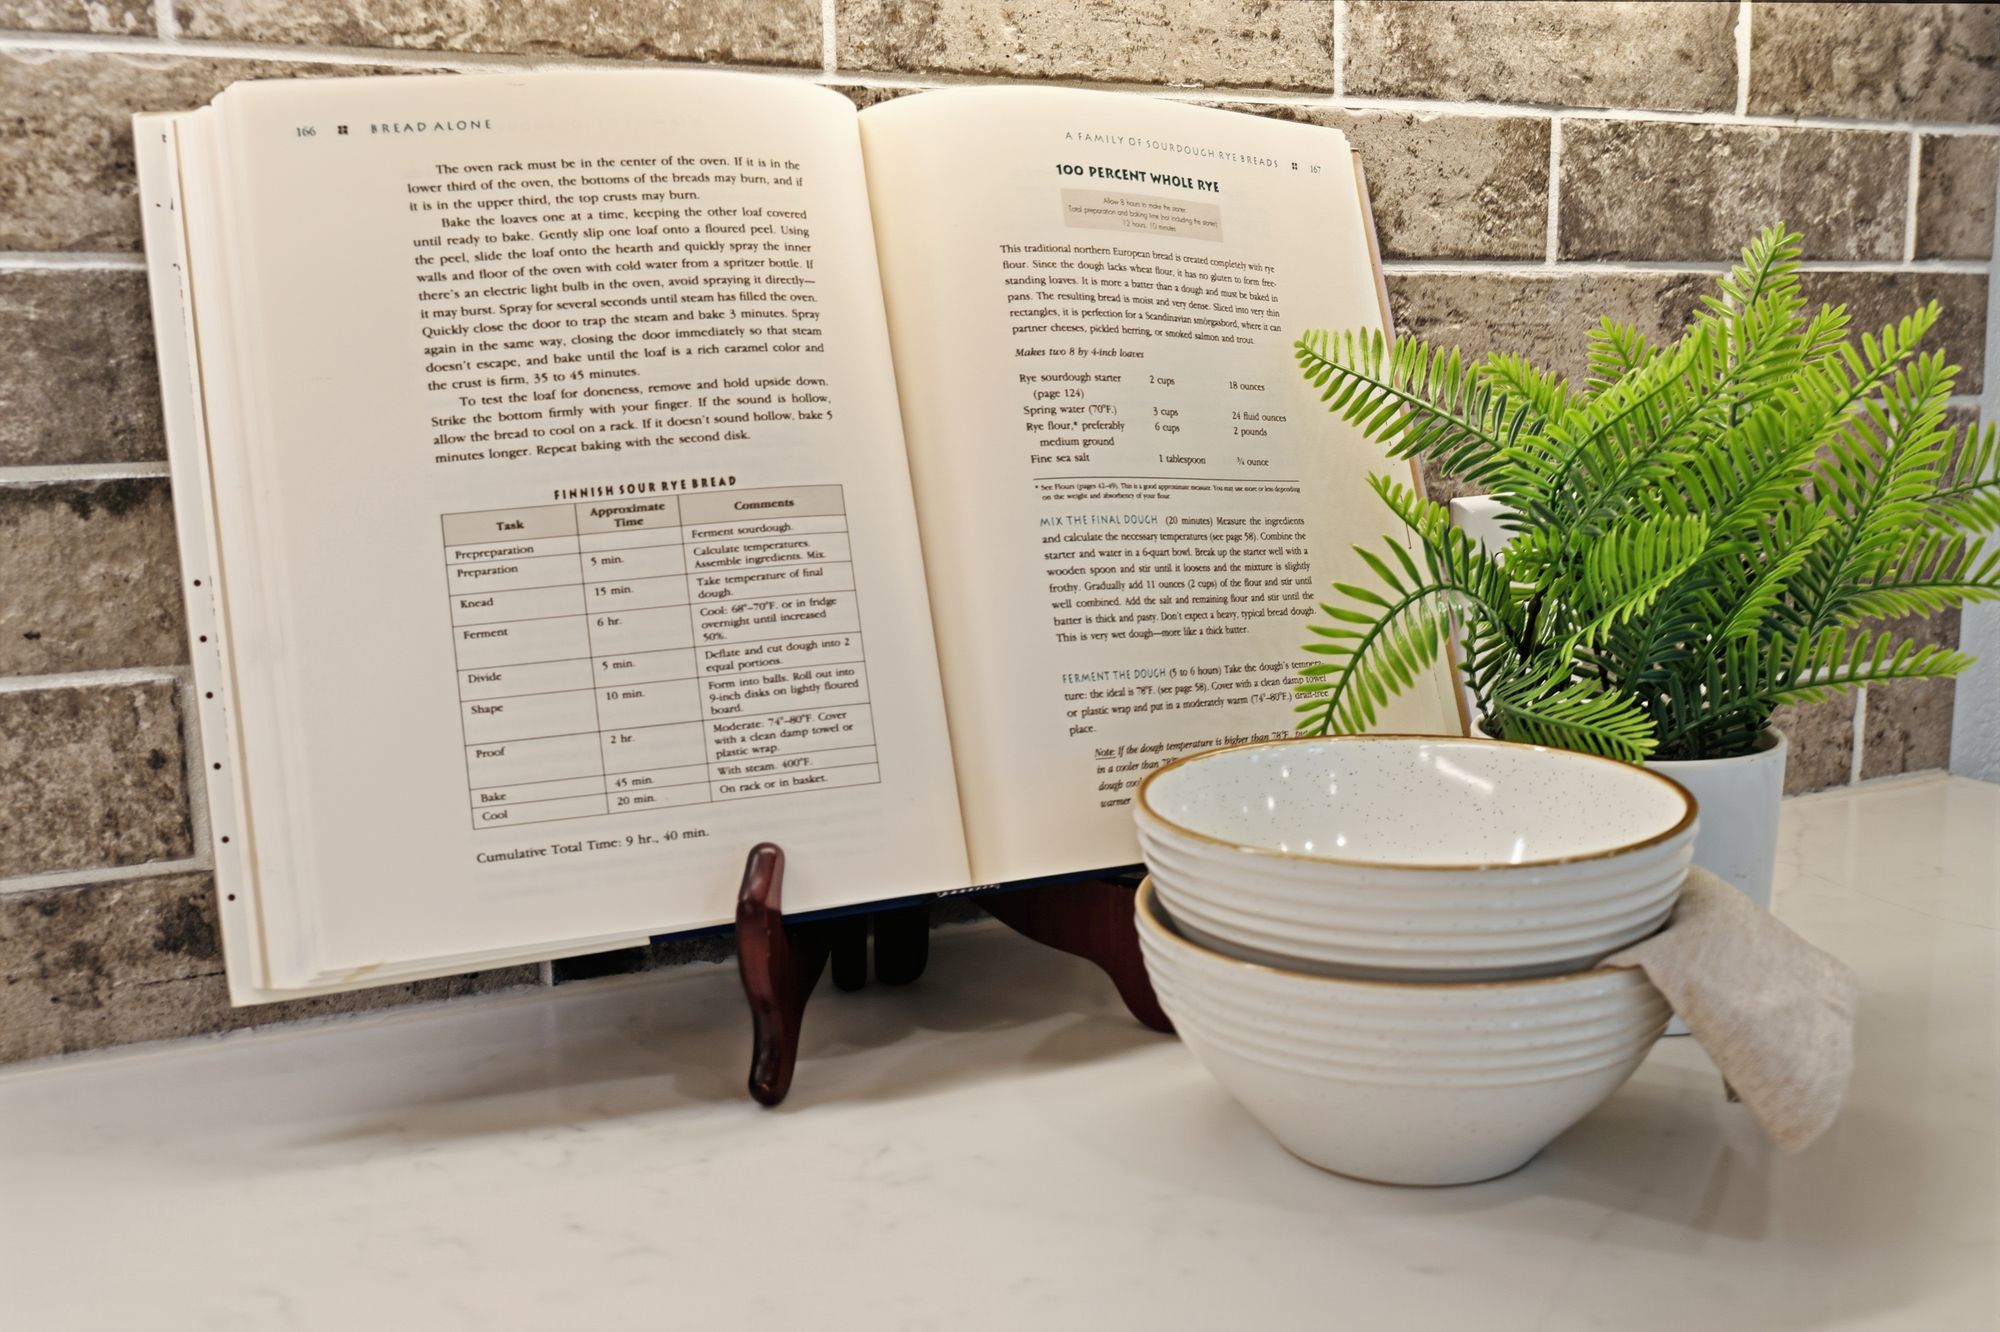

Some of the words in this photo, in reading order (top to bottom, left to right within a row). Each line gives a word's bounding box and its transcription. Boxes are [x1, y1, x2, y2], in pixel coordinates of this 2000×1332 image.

[296, 125, 317, 138] 166
[370, 122, 427, 134] BREAD
[434, 118, 493, 131] ALONE
[1065, 131, 1074, 140] A
[1078, 132, 1124, 144] FAMILY
[1128, 137, 1142, 146] OF
[1146, 139, 1215, 158] SOURDOUGH
[1218, 151, 1237, 162] RYE
[1240, 154, 1279, 169] BREADS
[434, 163, 460, 175] The
[463, 164, 494, 174] oven
[497, 160, 524, 172] rack
[526, 160, 558, 171] must
[560, 158, 576, 169] be
[580, 158, 593, 169] in
[596, 156, 616, 168] the
[619, 157, 657, 168] center
[660, 155, 674, 167] of
[676, 154, 696, 166] the
[698, 157, 730, 167] oven.
[733, 155, 744, 167] If
[746, 157, 755, 168] it
[757, 157, 767, 168] is
[769, 158, 781, 169] in
[783, 159, 801, 171] the
[1309, 164, 1322, 175] 167
[1055, 163, 1084, 176] 100
[1088, 165, 1147, 183] PERCENT
[1149, 172, 1194, 190] WHOLE
[1196, 178, 1220, 193] RYE
[440, 216, 471, 229] Bake
[475, 215, 496, 227] the
[500, 213, 539, 225] loaves
[541, 213, 566, 223] one
[570, 212, 582, 222] at
[586, 212, 594, 221] a
[597, 209, 629, 221] time,
[632, 207, 681, 221] keeping
[683, 206, 703, 217] the
[706, 205, 738, 217] other
[741, 206, 763, 217] loaf
[766, 209, 808, 220] covered
[999, 244, 1022, 254] This
[1023, 243, 1072, 253] traditional
[1073, 245, 1111, 255] northern
[1112, 247, 1151, 260] European
[1151, 250, 1174, 261] bread
[1175, 255, 1182, 263] is
[1182, 256, 1209, 266] created
[1209, 259, 1247, 272] completely
[1247, 263, 1263, 272] with
[1264, 265, 1275, 275] rye
[421, 323, 470, 340] Quickly
[472, 322, 505, 334] close
[508, 320, 528, 332] the
[531, 318, 562, 330] door
[565, 319, 579, 328] to
[581, 317, 607, 329] trap
[610, 313, 630, 325] the
[633, 313, 669, 324] steam
[672, 309, 695, 321] and
[697, 308, 726, 320] bake
[729, 308, 737, 320] 3
[740, 308, 788, 319] minutes.
[791, 308, 820, 322] Spray
[1015, 347, 1046, 358] Makes
[1048, 348, 1067, 356] two
[1068, 346, 1076, 356] 8
[1077, 346, 1089, 359] by
[1090, 347, 1118, 358] 4-inch
[1119, 348, 1145, 359] loaves
[1018, 373, 1037, 385] Rye
[1040, 371, 1092, 384] sourdough
[1094, 374, 1122, 383] starter
[1149, 374, 1155, 384] 2
[1156, 377, 1176, 387] cups
[1229, 380, 1239, 391] 18
[1239, 383, 1266, 392] ounces
[435, 452, 486, 464] minutes
[488, 448, 531, 460] longer.
[536, 444, 577, 457] Repeat
[580, 440, 622, 452] baking
[624, 436, 652, 448] with
[655, 434, 675, 446] the
[678, 431, 721, 444] second
[723, 429, 751, 441] disk.
[1039, 436, 1080, 447] medium
[1082, 436, 1115, 449] ground
[1030, 454, 1053, 464] Fine
[1055, 455, 1072, 463] sea
[1074, 452, 1090, 462] salt
[1159, 454, 1163, 463] 1
[1165, 454, 1207, 466] tablespoon
[553, 484, 615, 501] FINNISH
[618, 481, 657, 496] SOUR
[660, 478, 687, 492] RYE
[691, 475, 737, 490] BREAD
[589, 502, 666, 517] Approximate
[733, 498, 796, 511] Comments
[495, 519, 526, 532] Task
[612, 517, 645, 529] Time
[1039, 516, 1064, 527] MIX
[1065, 514, 1088, 526] THE
[1090, 514, 1121, 525] FINAL
[1123, 514, 1159, 525] DOUGH
[1164, 515, 1179, 527] (20
[1180, 515, 1214, 528] minutes)
[1215, 516, 1247, 526] Measure
[1249, 515, 1262, 526] the
[1264, 516, 1305, 528] ingredients
[454, 545, 535, 561] Prepreparation
[590, 556, 597, 566] 5
[601, 556, 624, 565] min.
[456, 564, 519, 579] Preparation
[594, 586, 607, 597] 15
[610, 585, 634, 596] min.
[459, 596, 495, 609] Knead
[596, 618, 604, 627] 6
[607, 616, 623, 626] hr.
[462, 628, 509, 641] Ferment
[602, 661, 609, 670] 5
[612, 661, 636, 669] min.
[467, 671, 503, 685] Divide
[1061, 671, 1111, 685] FERMENT
[1113, 668, 1132, 680] THE
[1133, 667, 1167, 680] DOUGH
[606, 691, 619, 701] 10
[621, 689, 645, 699] min.
[470, 704, 504, 716] Shape
[1068, 723, 1097, 738] place.
[610, 735, 617, 744] 2
[620, 734, 636, 743] hr.
[475, 745, 507, 759] Proof
[614, 777, 628, 788] 45
[631, 776, 654, 786] min.
[480, 791, 508, 804] Bake
[617, 796, 630, 806] 20
[633, 795, 657, 804] min.
[481, 809, 509, 822] Cool
[476, 847, 548, 864] Cumulative
[550, 840, 583, 855] Total
[585, 839, 622, 851] Time:
[625, 835, 634, 847] 9
[637, 833, 660, 845] hr.,
[663, 830, 679, 841] 40
[682, 828, 710, 840] min.
